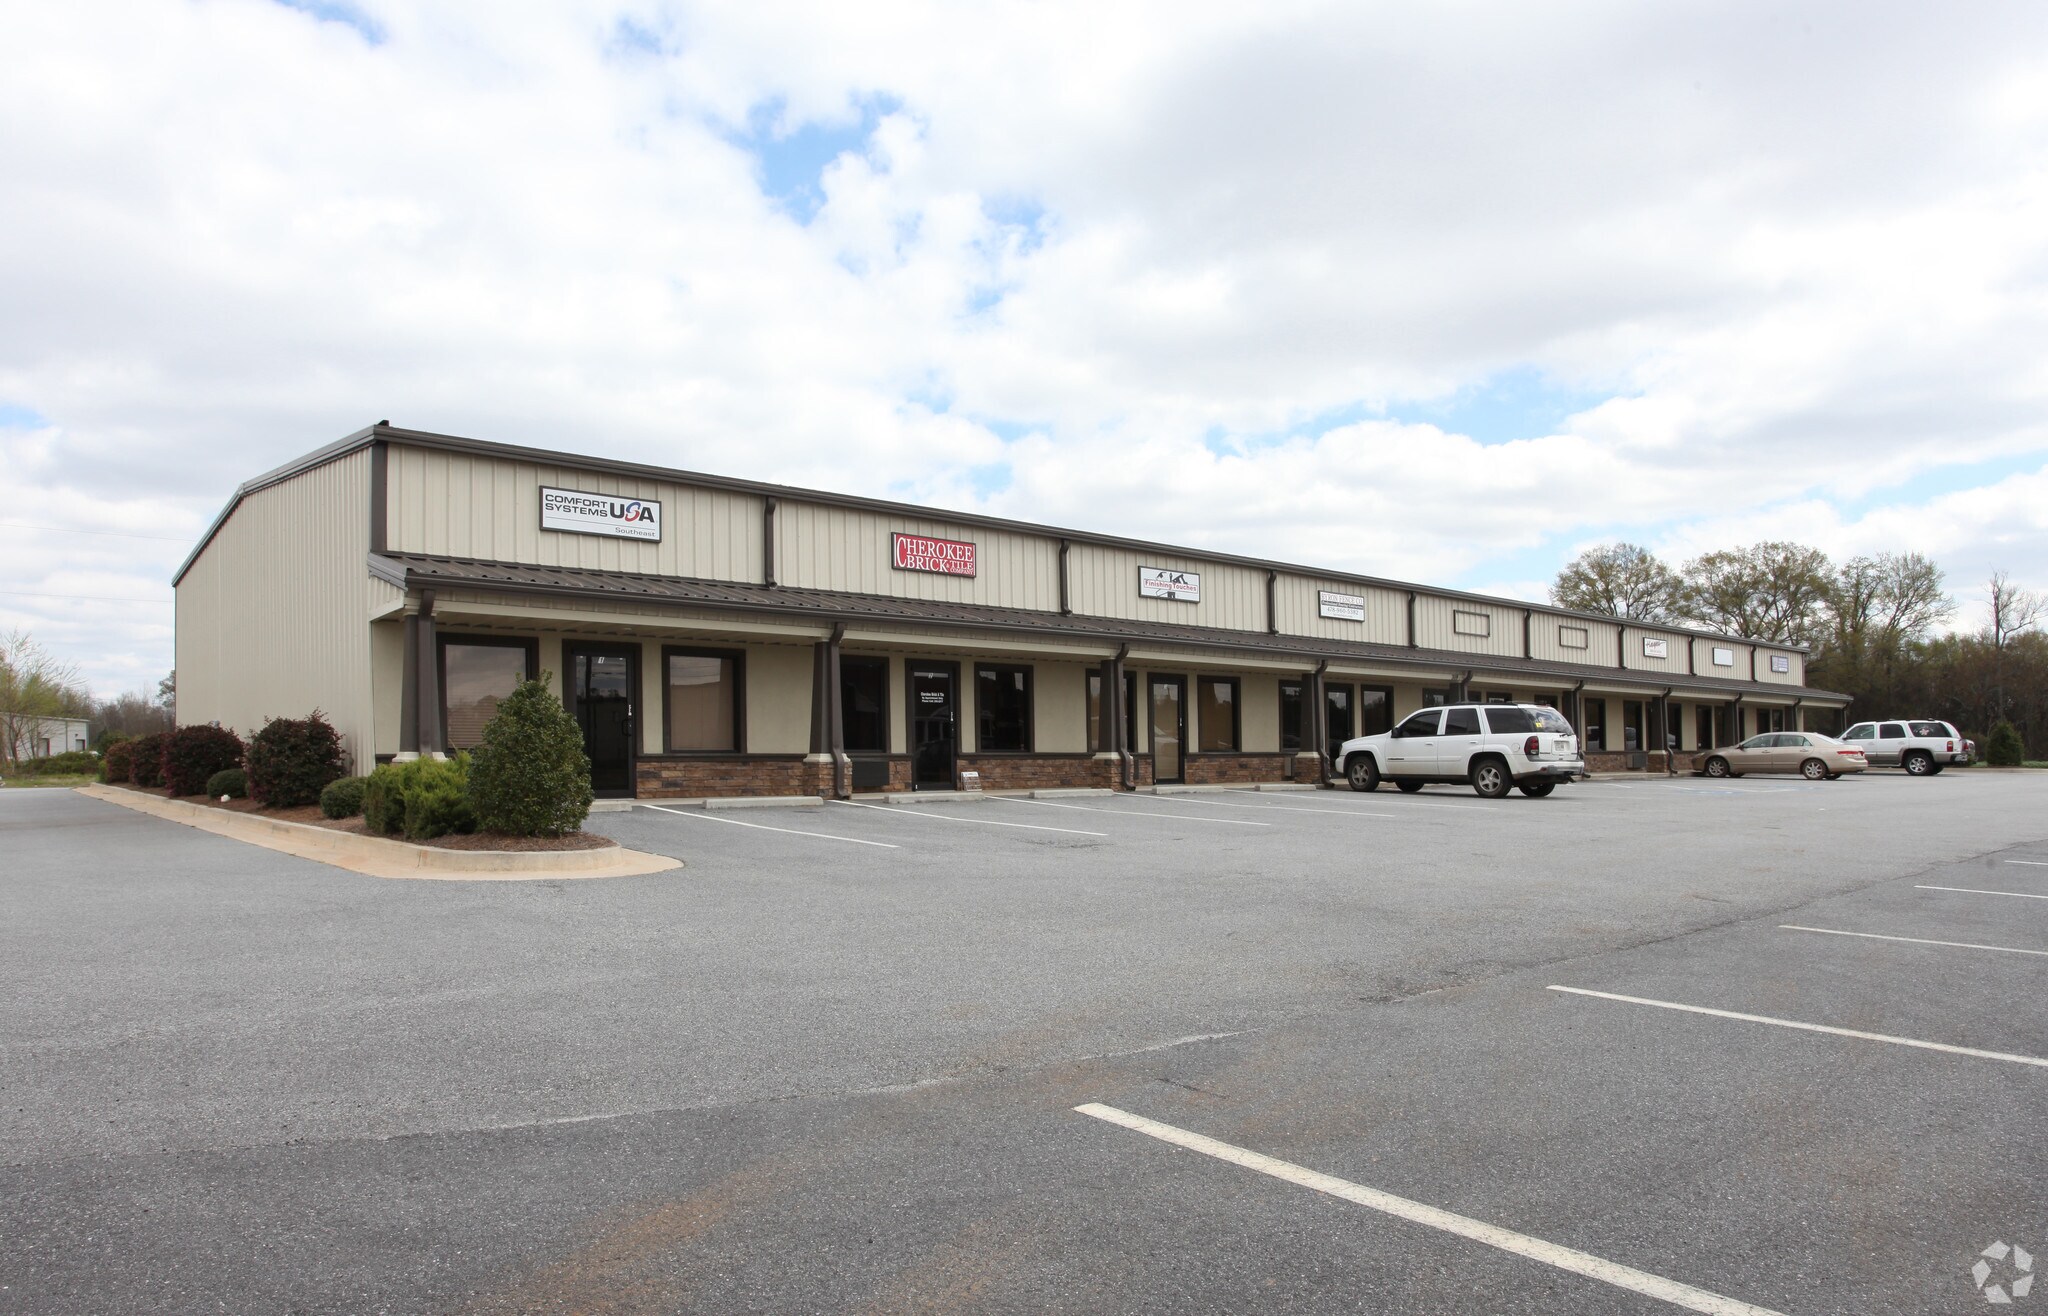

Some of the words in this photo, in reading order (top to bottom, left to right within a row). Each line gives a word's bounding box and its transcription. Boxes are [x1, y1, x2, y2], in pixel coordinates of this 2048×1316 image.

[545, 494, 608, 508] COMFORT
[609, 501, 655, 523] USA
[545, 502, 608, 517] SYSTEMS
[615, 526, 656, 537] Southeast
[896, 537, 973, 567] CHEROKEE
[906, 554, 949, 573] BRICK
[950, 560, 974, 570] TILE
[950, 567, 974, 576] COMPANY
[1145, 580, 1172, 590] Finishing
[1173, 583, 1197, 592] Touches
